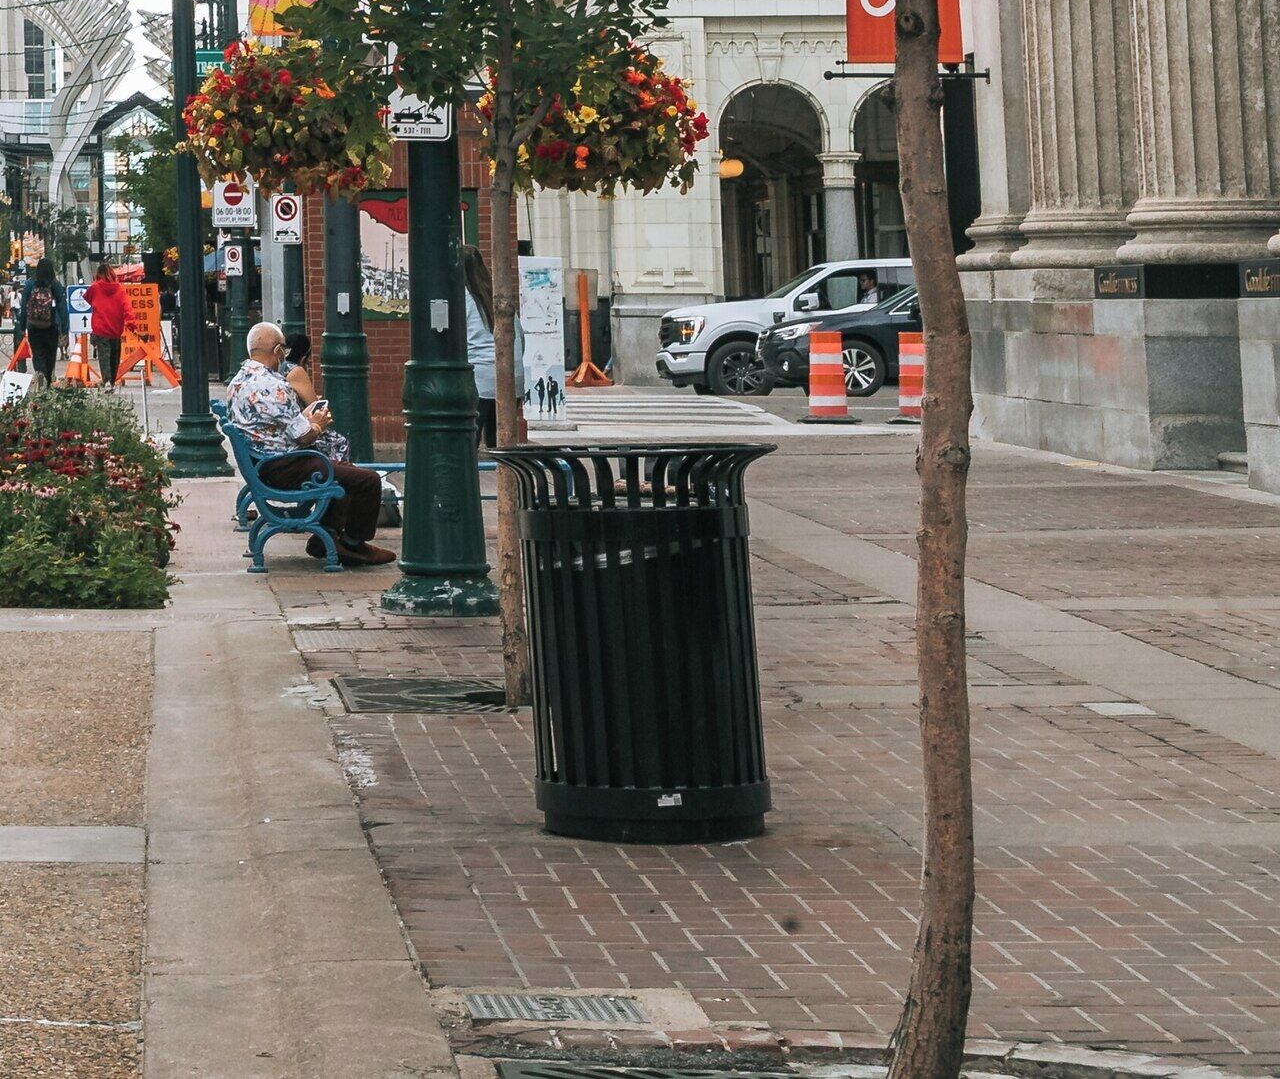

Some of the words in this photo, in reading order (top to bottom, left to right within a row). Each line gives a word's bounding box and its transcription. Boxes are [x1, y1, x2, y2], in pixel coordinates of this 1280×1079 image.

[196, 60, 225, 72] TREET
[126, 287, 153, 297] ICLE
[131, 299, 154, 309] ESS
